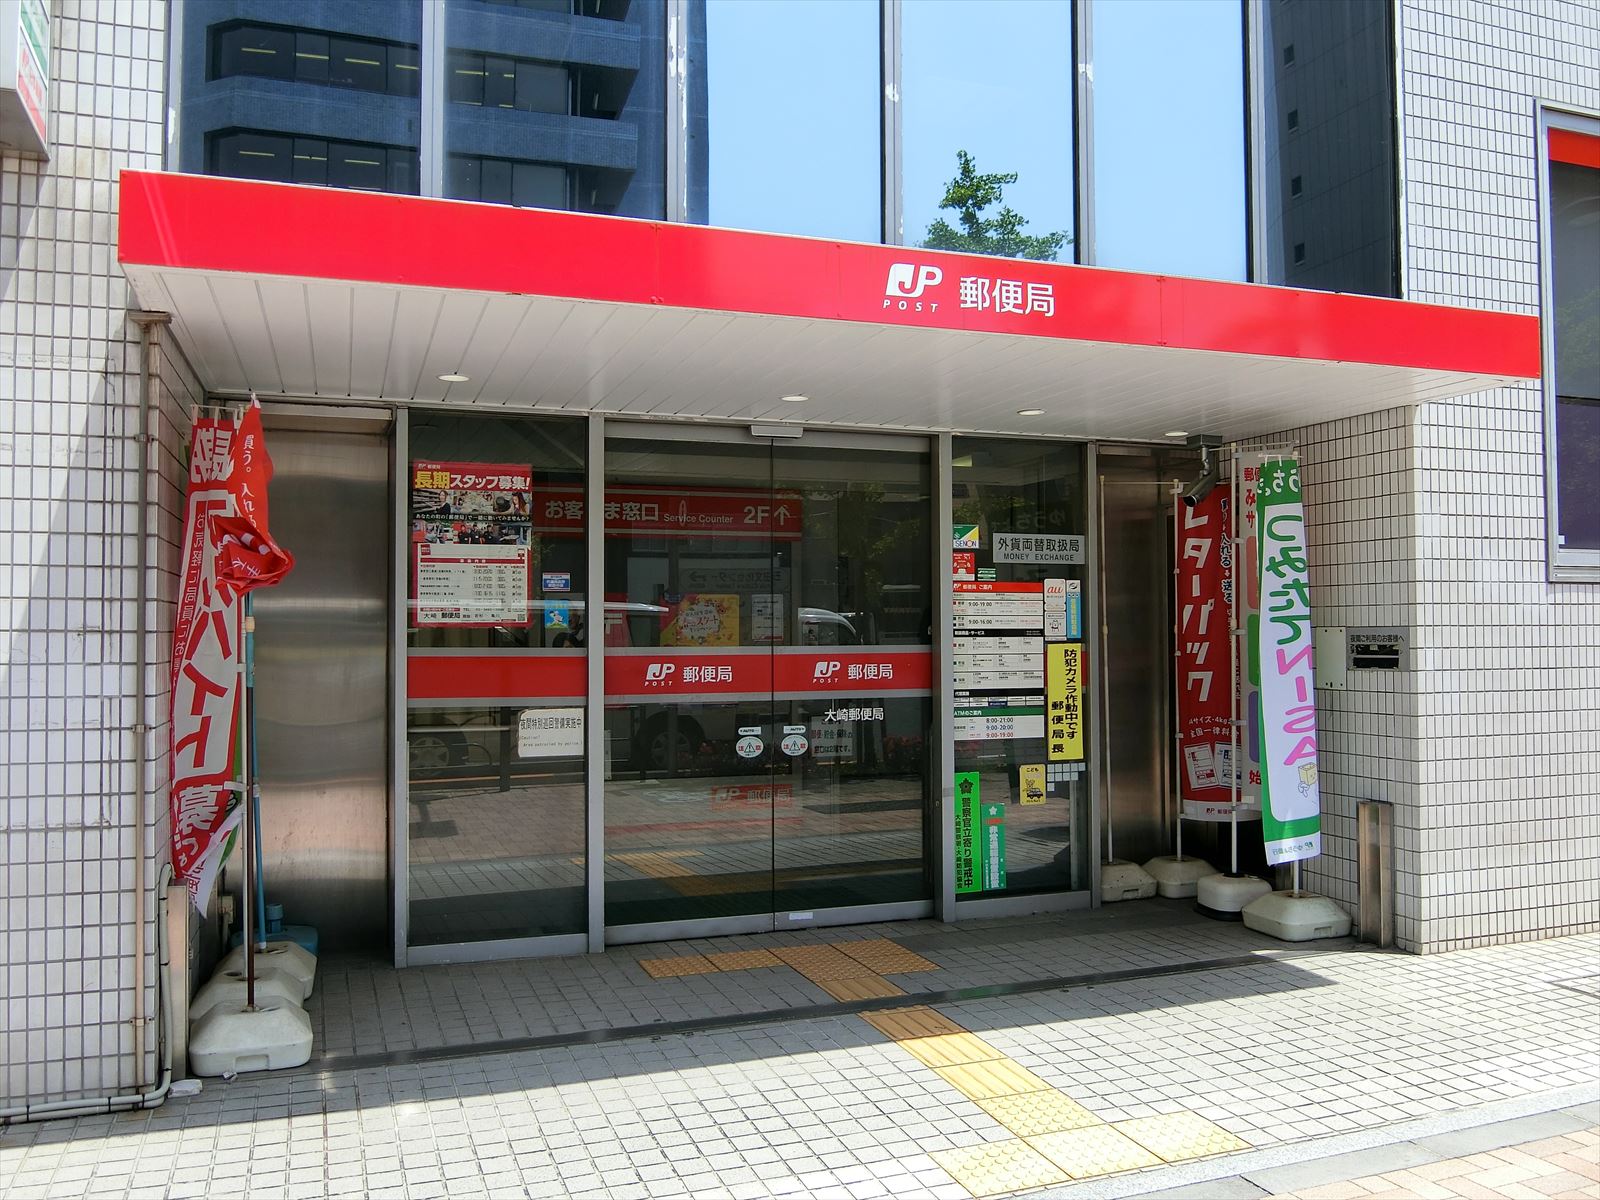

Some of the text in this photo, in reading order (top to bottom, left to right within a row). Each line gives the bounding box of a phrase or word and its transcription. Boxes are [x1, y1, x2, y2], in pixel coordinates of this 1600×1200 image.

[883, 299, 939, 312] POST
[959, 276, 1055, 317] 郵便局
[545, 500, 770, 524] お客ま窓口 Service Counter 2F
[954, 539, 977, 548] SENON
[997, 537, 1080, 553] 外貨両替取扱局
[1003, 552, 1075, 561] MONEY EXCHANGE
[1047, 586, 1064, 594] au
[1183, 504, 1215, 702] レターパック
[682, 665, 733, 684] 郵便局
[847, 663, 894, 681] 郵便局
[1063, 648, 1079, 740] 防犯カメラ作動中です
[823, 707, 885, 723] 大崎郵便局
[1051, 700, 1065, 754] 郵便局長
